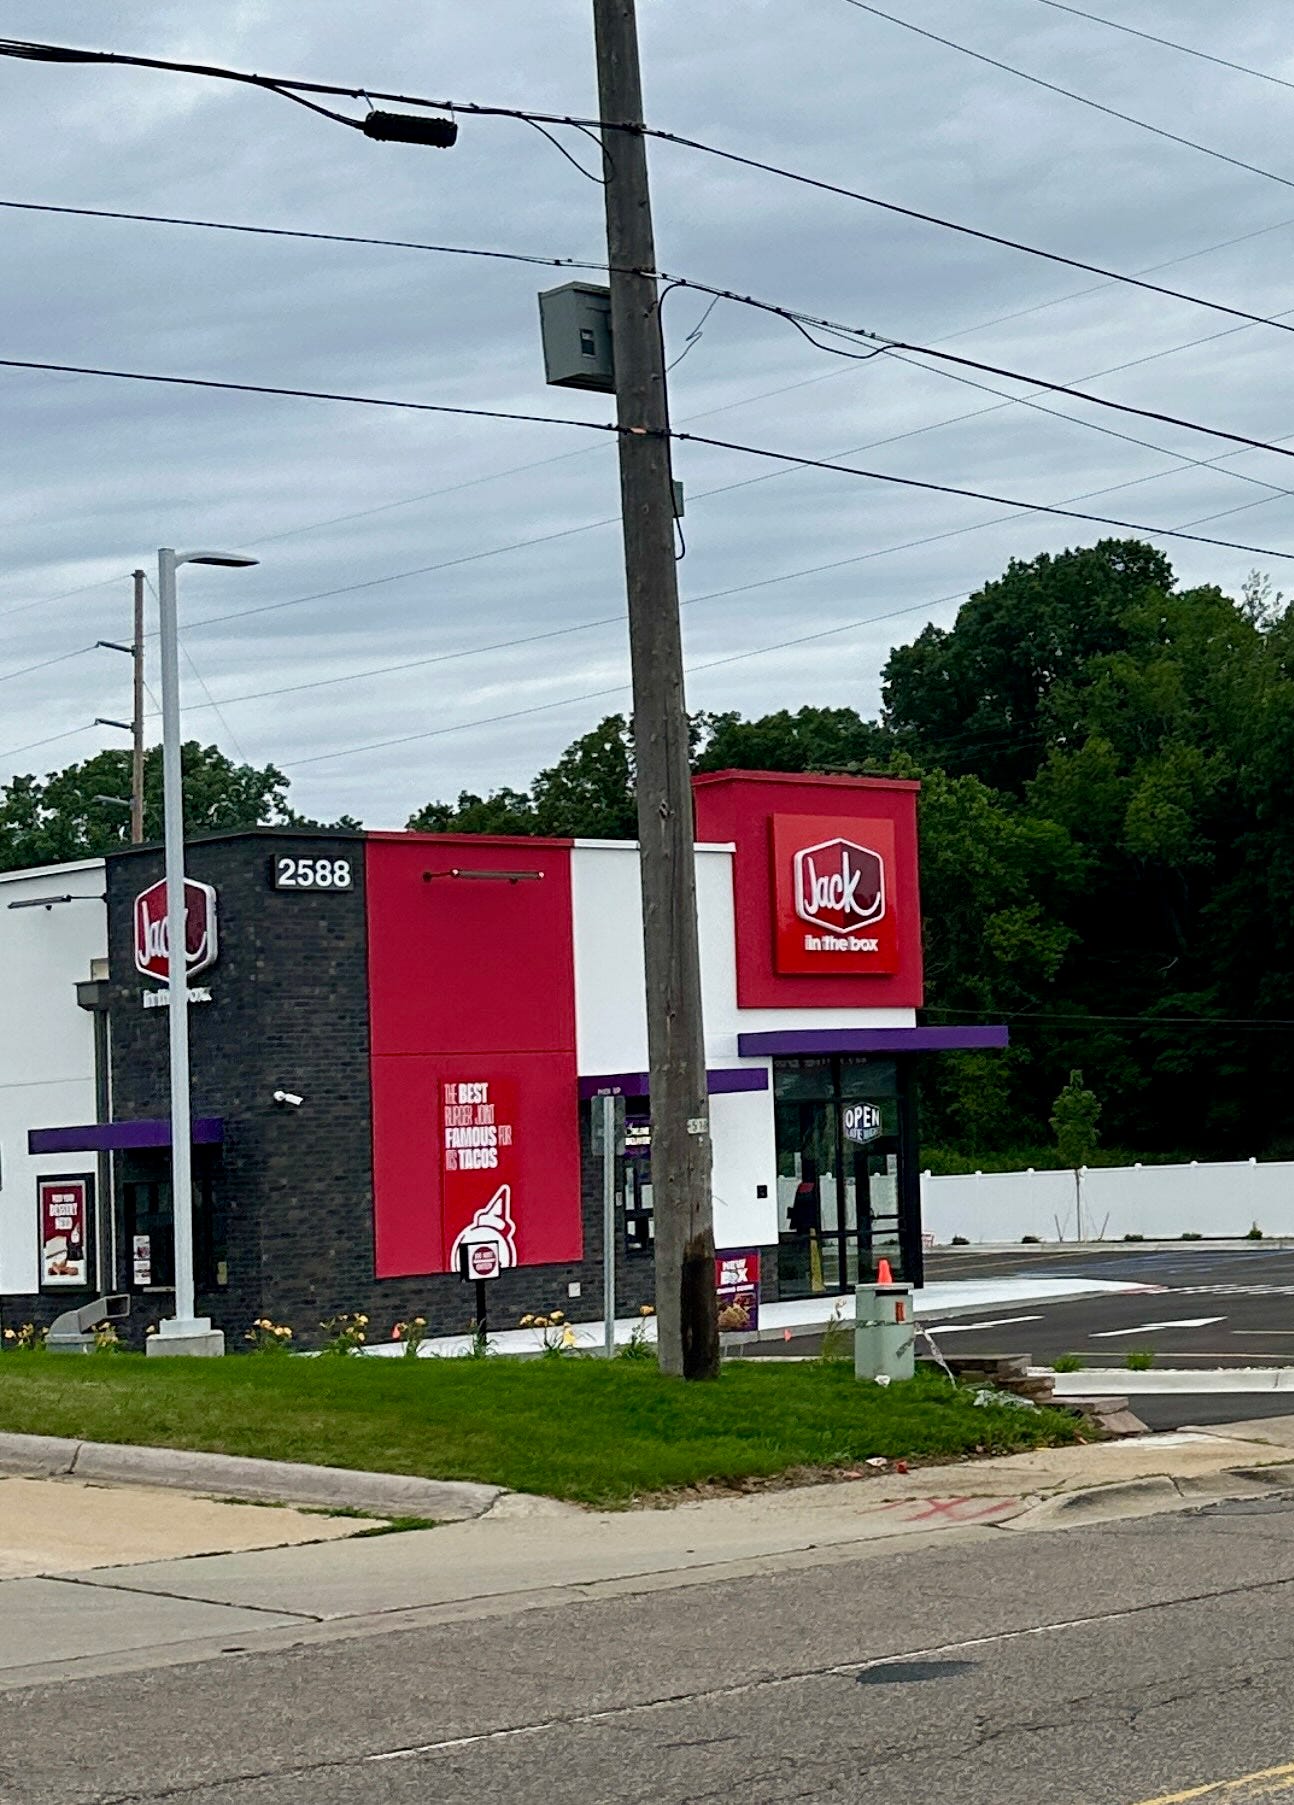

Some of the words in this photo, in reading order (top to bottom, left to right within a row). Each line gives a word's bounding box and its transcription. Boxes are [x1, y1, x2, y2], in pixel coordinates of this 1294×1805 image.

[278, 858, 352, 888] 2588
[804, 851, 881, 917] Jack
[805, 934, 820, 951] in
[822, 935, 848, 951] the
[848, 936, 879, 952] box
[458, 1082, 488, 1104] BEST
[845, 1105, 880, 1129] OPEN
[445, 1126, 498, 1149] FAMOUS
[458, 1147, 499, 1170] TACOS
